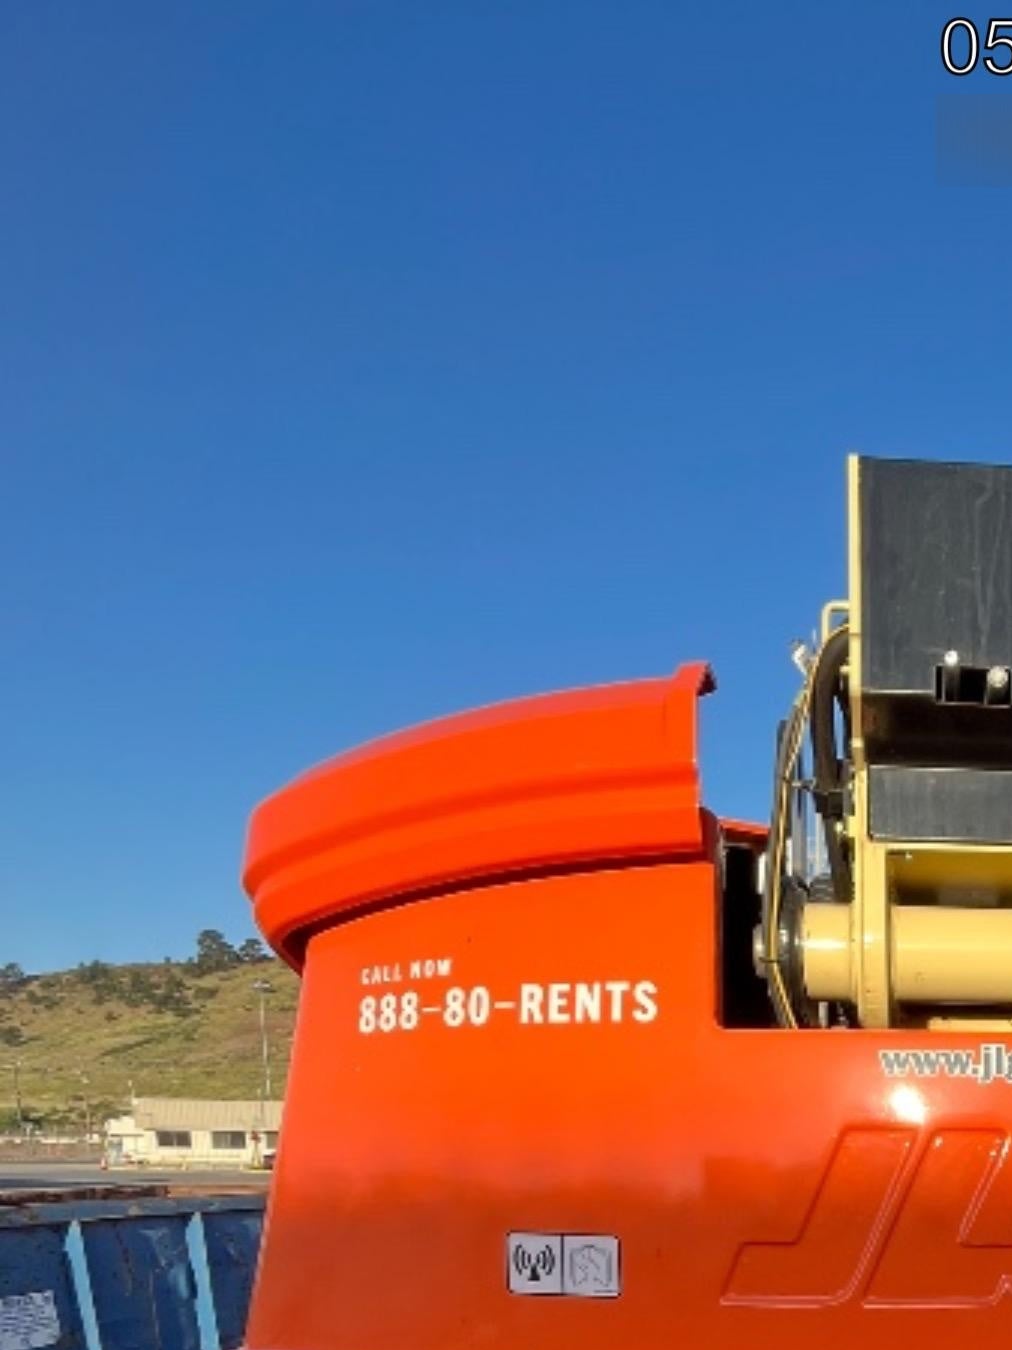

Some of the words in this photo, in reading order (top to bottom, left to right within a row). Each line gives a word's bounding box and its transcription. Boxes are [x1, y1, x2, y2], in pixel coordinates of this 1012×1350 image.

[361, 964, 402, 985] CALL
[410, 958, 454, 980] NOW
[358, 980, 659, 1035] 888-80-RENTS
